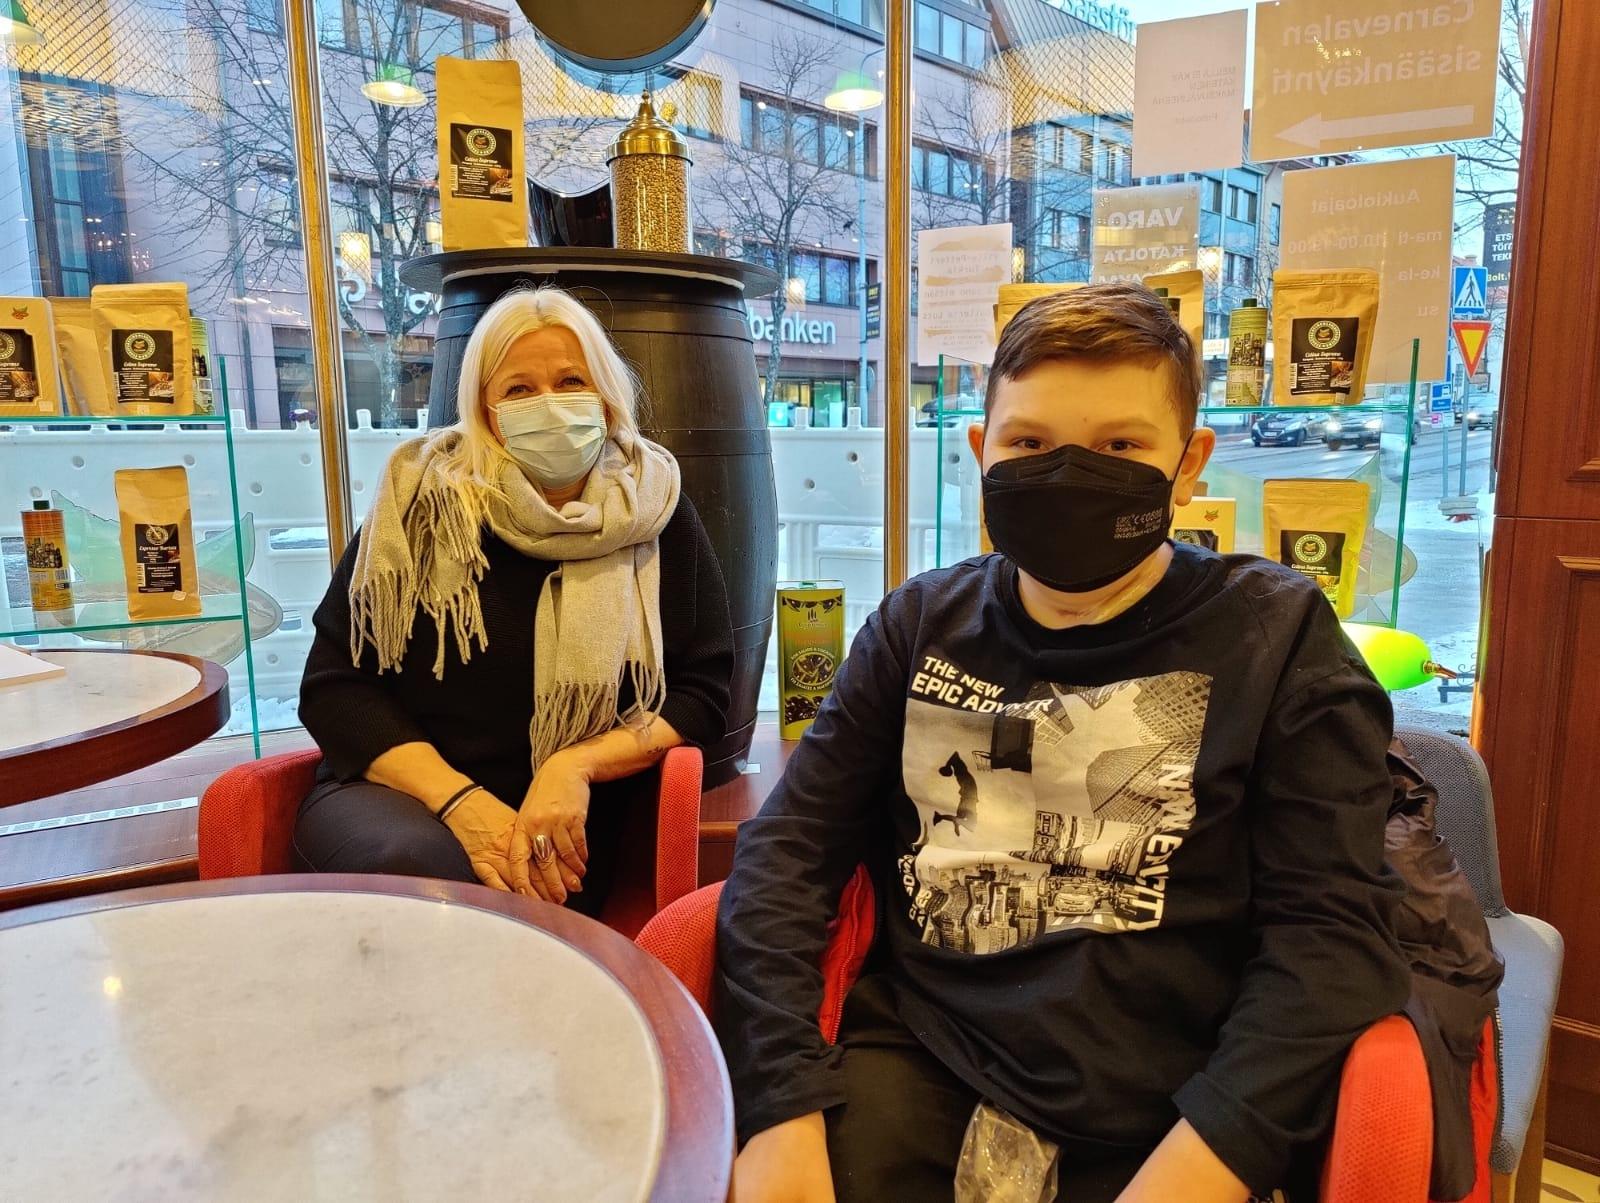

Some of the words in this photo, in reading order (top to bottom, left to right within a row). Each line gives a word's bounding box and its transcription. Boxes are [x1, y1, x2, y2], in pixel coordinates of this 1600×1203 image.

[1495, 232, 1513, 242] ETS
[911, 671, 964, 705] EPIC
[923, 655, 959, 680] THE
[960, 673, 1006, 699] NEW
